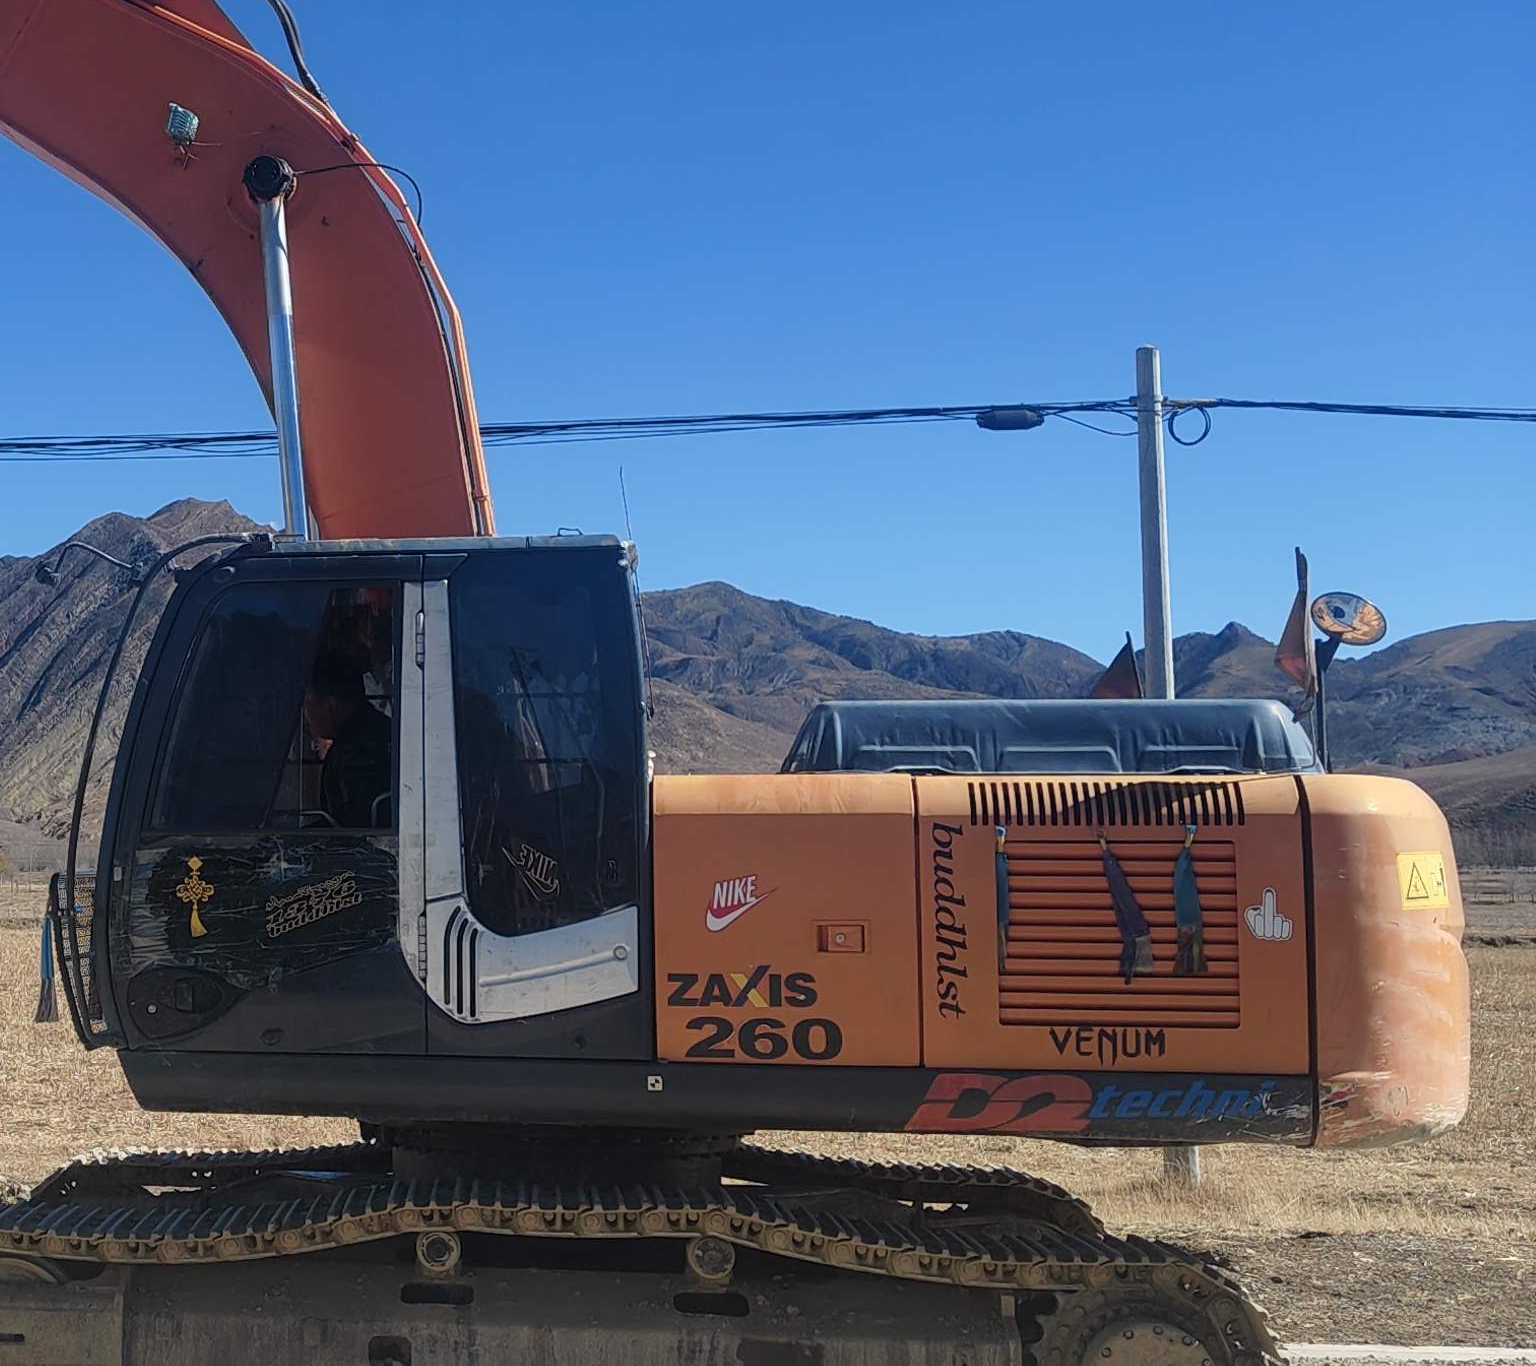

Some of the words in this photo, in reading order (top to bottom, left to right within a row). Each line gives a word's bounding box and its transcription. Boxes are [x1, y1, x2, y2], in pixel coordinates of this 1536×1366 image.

[713, 874, 758, 910] NIKE
[667, 964, 818, 1008] ZAXIS
[684, 1016, 843, 1060] 260
[1048, 1026, 1167, 1067] VENUM
